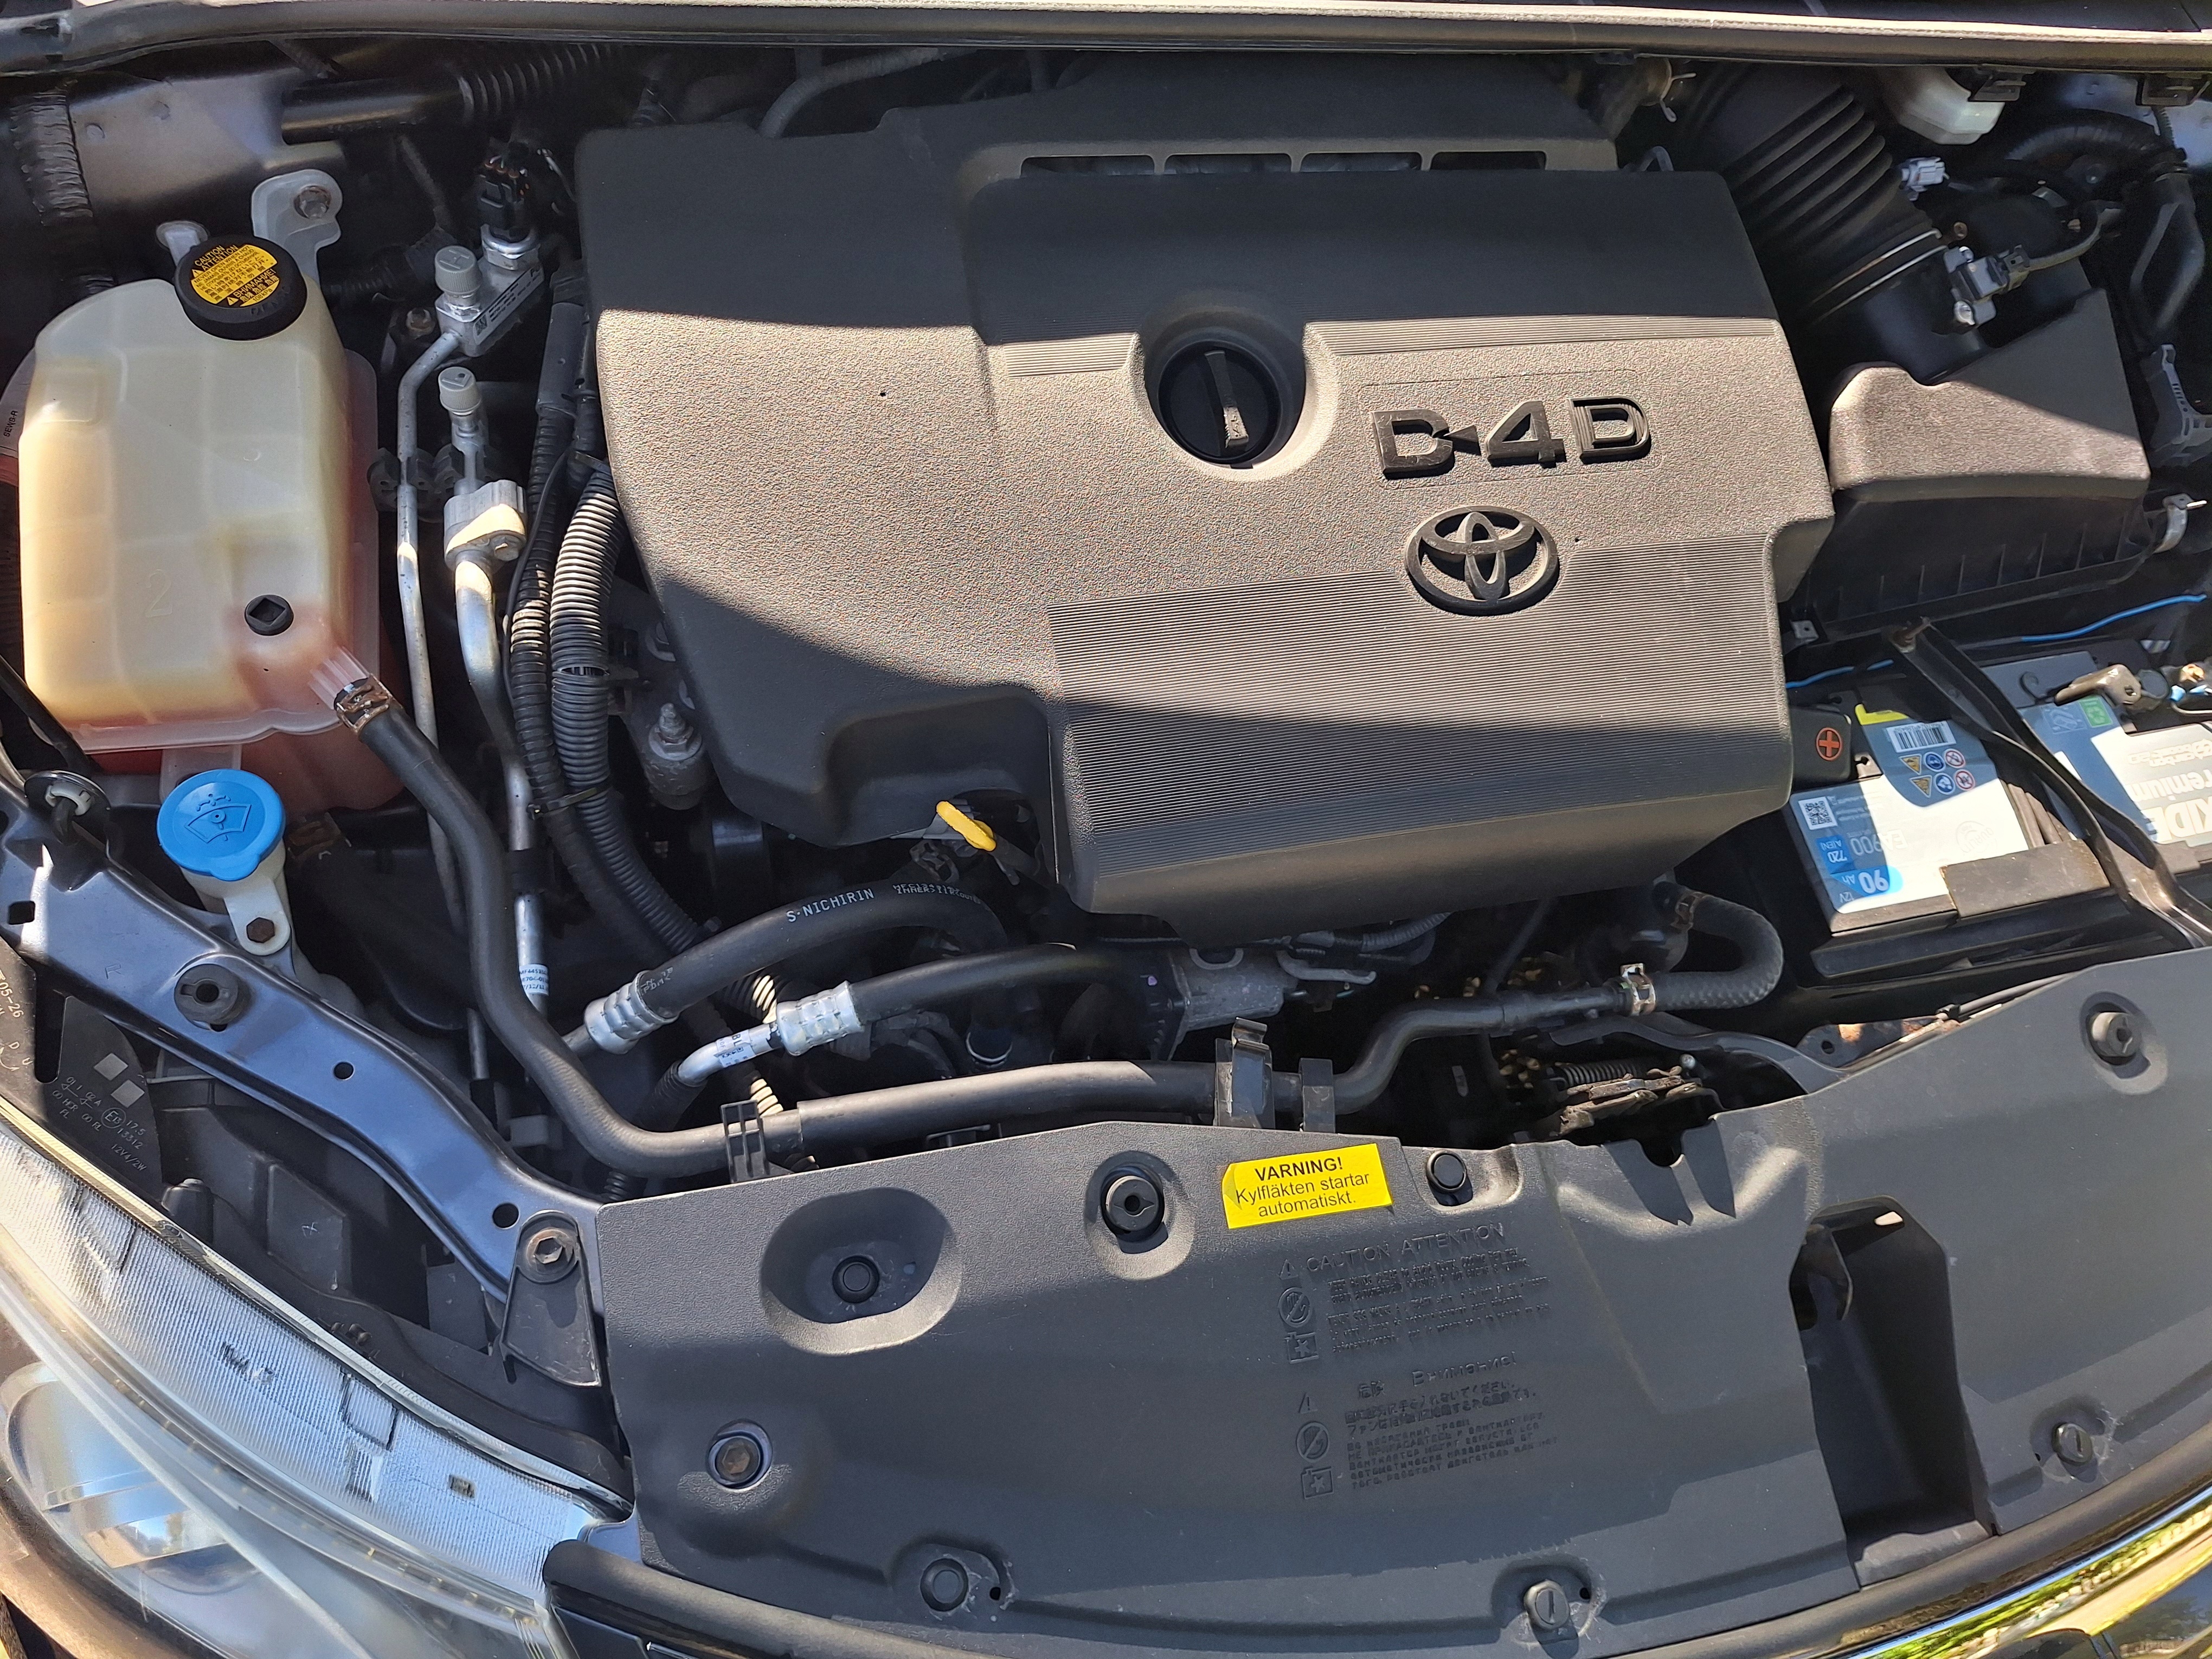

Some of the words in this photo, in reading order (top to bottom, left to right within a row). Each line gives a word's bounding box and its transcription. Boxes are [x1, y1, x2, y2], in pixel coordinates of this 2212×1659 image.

[194, 271, 211, 283] NEVER
[211, 262, 225, 272] OPEN
[225, 252, 239, 263] WHEN
[195, 245, 225, 266] CAUTION
[201, 245, 239, 271] ATTENTION
[203, 271, 219, 282] JAMAIS
[219, 261, 235, 273] OUVRIR
[233, 268, 276, 298] ВНИМАНИЕ!
[1371, 395, 1651, 479] D-4D
[1850, 828, 1909, 857] EA900
[1827, 849, 1848, 864] 720
[1842, 874, 1855, 885] Ah
[1858, 869, 1890, 895] 90
[1840, 891, 1854, 903] 12V
[8, 1041, 20, 1050] D
[732, 1033, 742, 1047] BL
[117, 1128, 143, 1149] 13312
[126, 1120, 146, 1136] 17.5
[111, 1143, 147, 1172] 12V4/2W
[1255, 1156, 1343, 1181] VARNING!
[1236, 1181, 1315, 1206] Kylfläkten
[1320, 1173, 1370, 1191] startar
[1258, 1191, 1356, 1217] automatiskt.
[1306, 1243, 1390, 1272] CAUTION
[1401, 1222, 1504, 1255] ATTENTION
